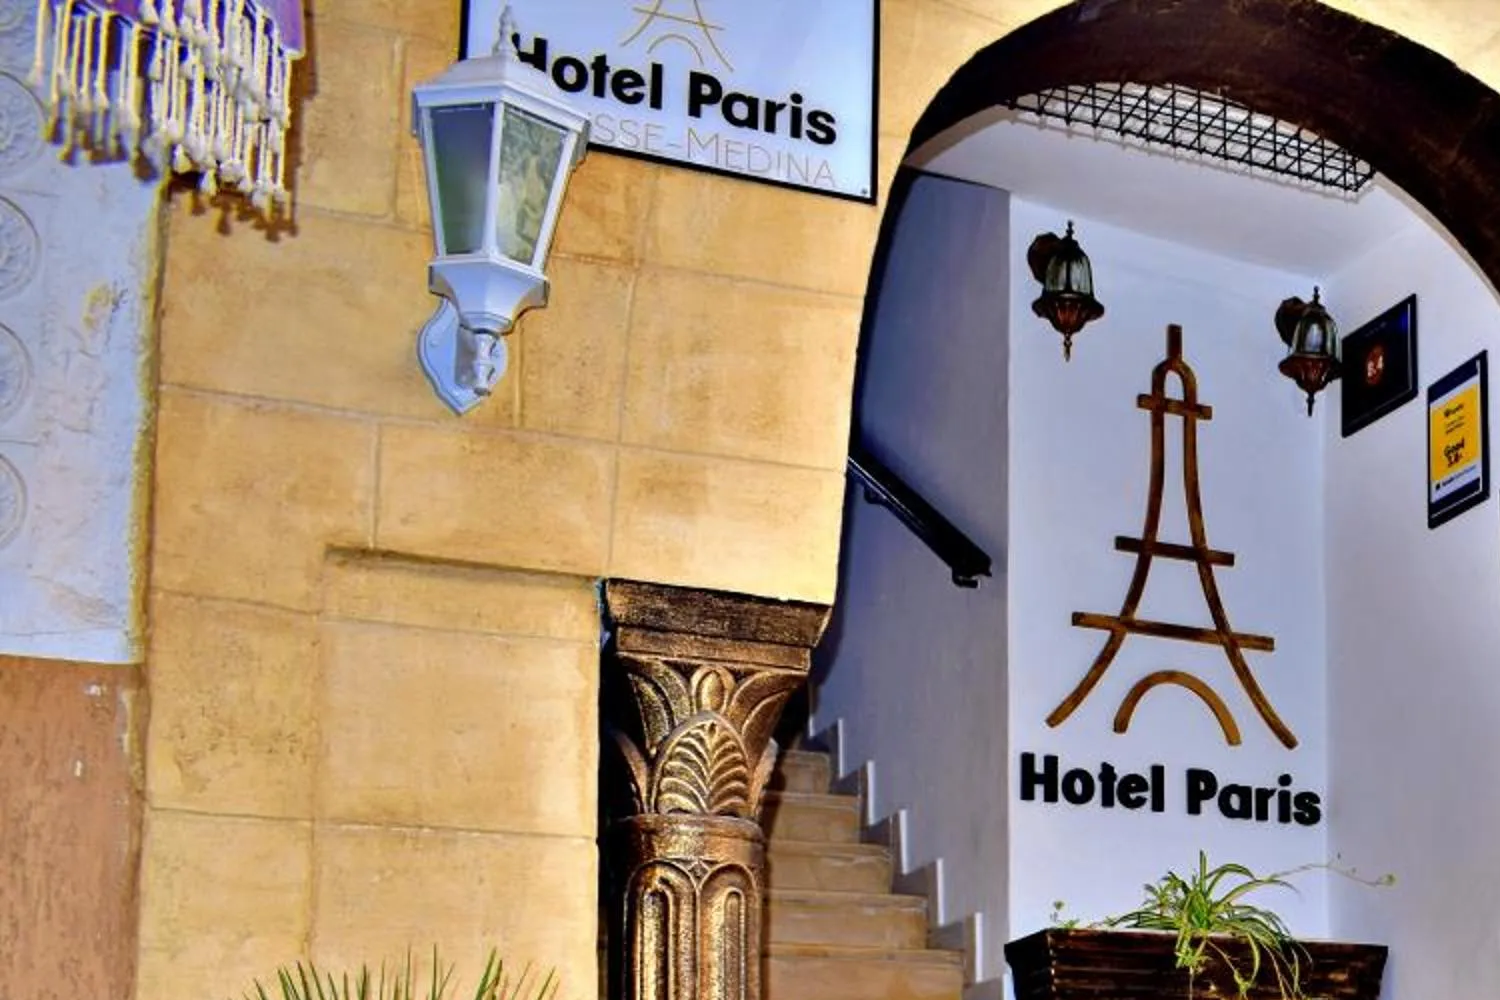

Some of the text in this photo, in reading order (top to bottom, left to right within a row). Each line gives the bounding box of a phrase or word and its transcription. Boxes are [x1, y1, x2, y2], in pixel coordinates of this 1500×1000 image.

[511, 32, 838, 146] Hotel Paris
[588, 111, 838, 188] SSE-MEDINA
[1019, 751, 1322, 826] Hotel Paris
